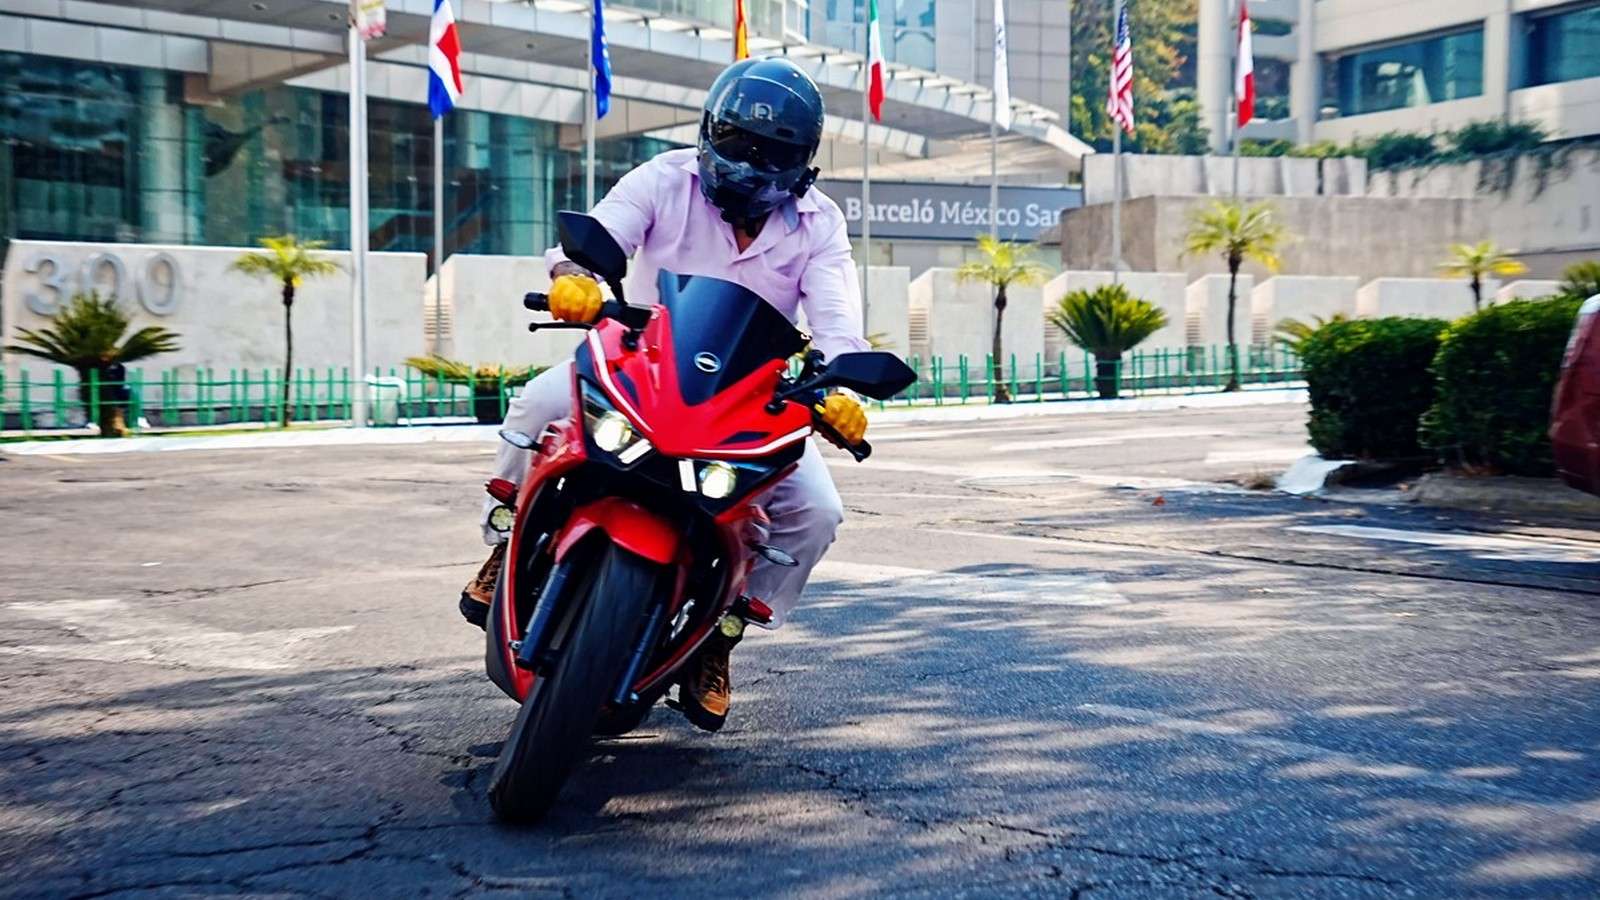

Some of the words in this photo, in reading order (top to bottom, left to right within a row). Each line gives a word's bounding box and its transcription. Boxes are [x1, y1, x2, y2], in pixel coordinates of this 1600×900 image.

[846, 197, 935, 224] Barceló
[940, 200, 1021, 227] México
[24, 252, 181, 317] 300
